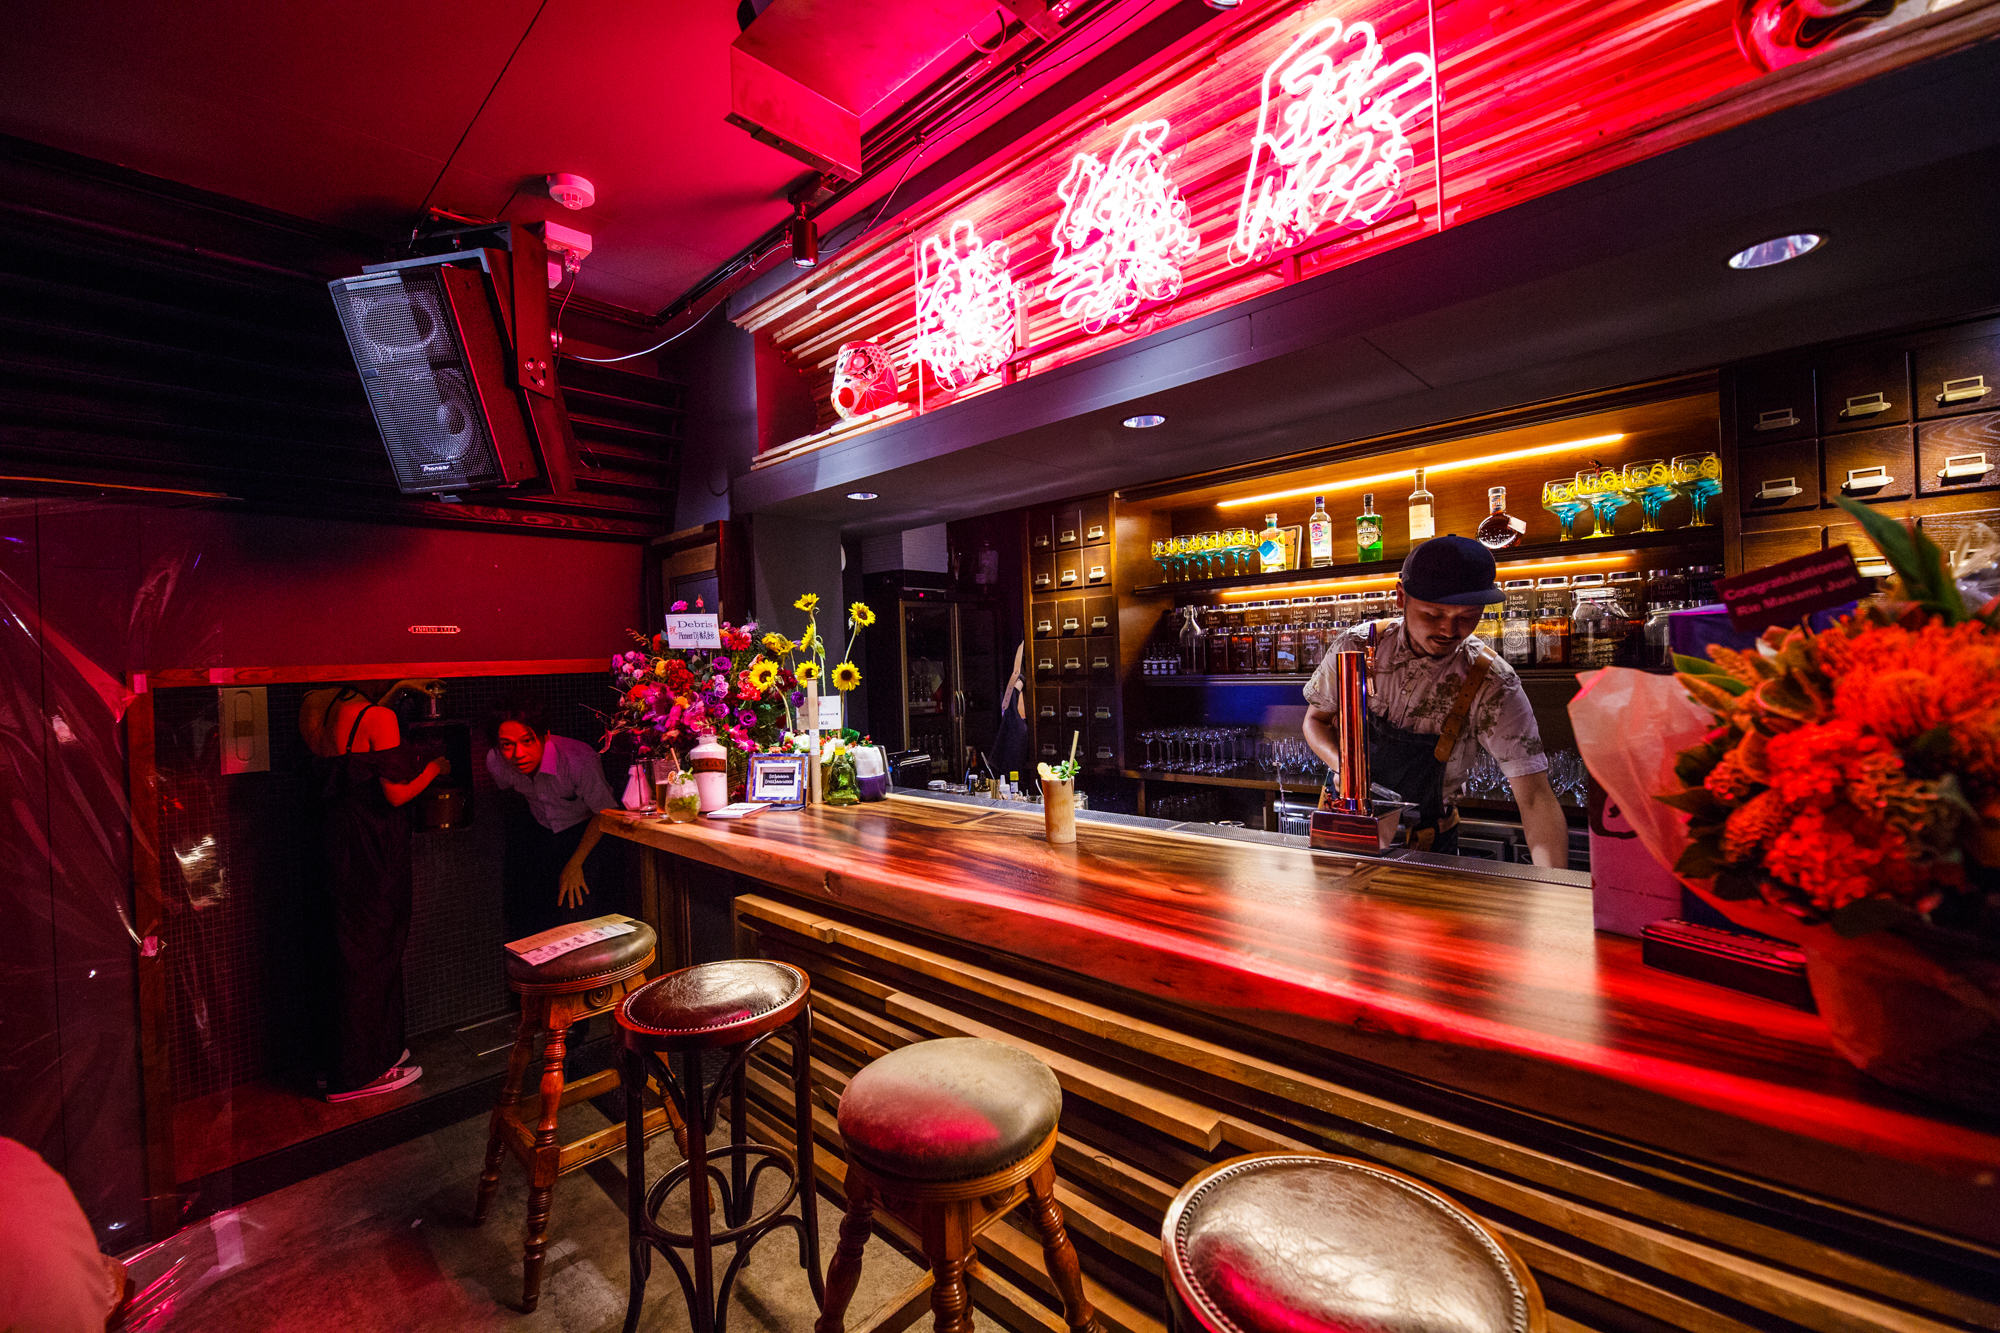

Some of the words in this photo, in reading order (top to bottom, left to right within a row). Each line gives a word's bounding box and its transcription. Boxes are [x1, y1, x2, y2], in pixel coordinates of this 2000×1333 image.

[423, 464, 450, 472] Pioneer
[677, 620, 713, 629] Debris
[669, 625, 678, 635] 祝
